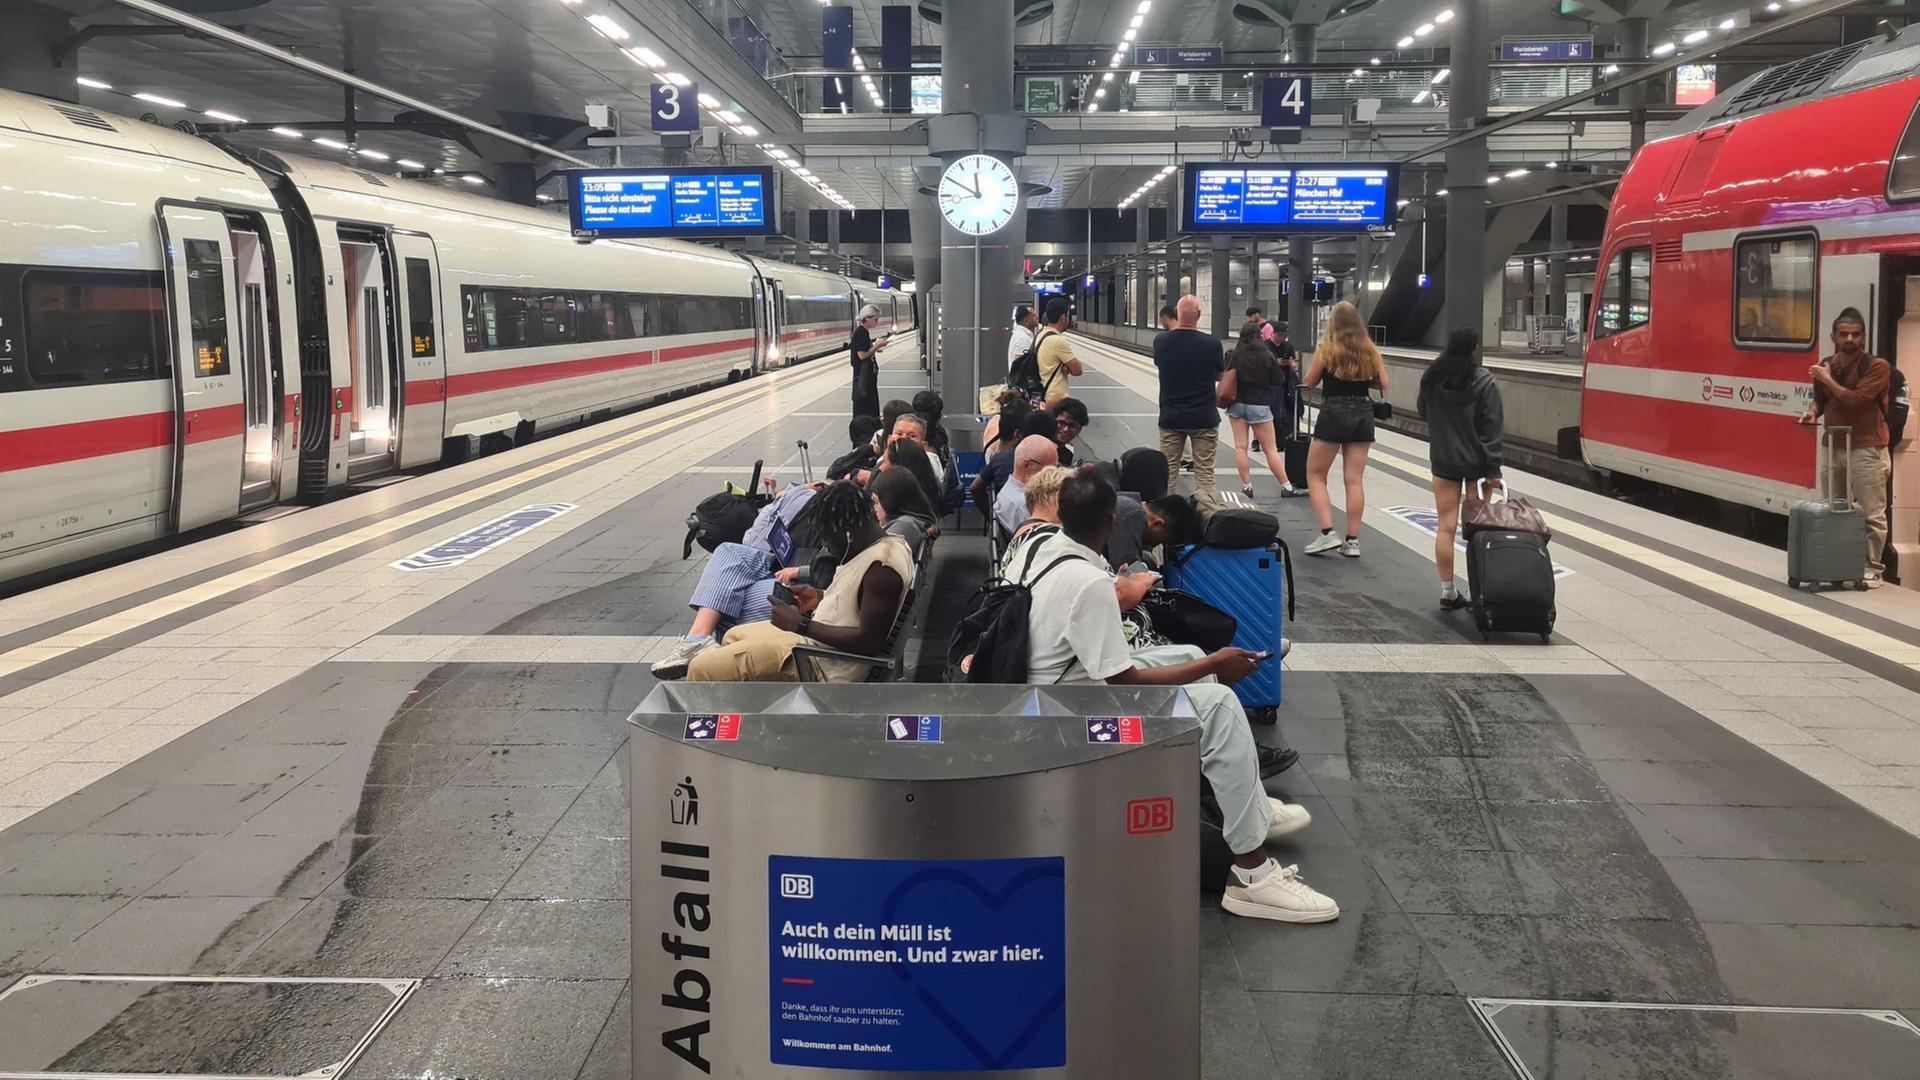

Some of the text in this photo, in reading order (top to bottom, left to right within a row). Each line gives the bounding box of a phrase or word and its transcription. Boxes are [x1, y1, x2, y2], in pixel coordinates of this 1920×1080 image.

[657, 84, 680, 120] 3
[1281, 79, 1304, 115] 4
[584, 194, 656, 204] Bitte nicht einsteigen
[585, 204, 652, 214] Please do not board
[878, 276, 885, 287] F
[1087, 275, 1094, 287] F
[1418, 274, 1426, 286] F
[466, 294, 474, 318] 2
[5, 339, 11, 352] 5
[1130, 800, 1170, 832] DB
[783, 876, 811, 897] DB
[781, 920, 952, 942] Auch dein Müll ist
[661, 840, 712, 1075] Abfall
[781, 942, 1045, 963] willkommen. Und zwar hier.
[781, 1001, 905, 1017] Danke, dass ihr uns unterstützt,
[781, 1011, 901, 1026] den Bahnhof sauber zu halten.
[782, 1037, 893, 1053] Willkommen am Bahnhof.
